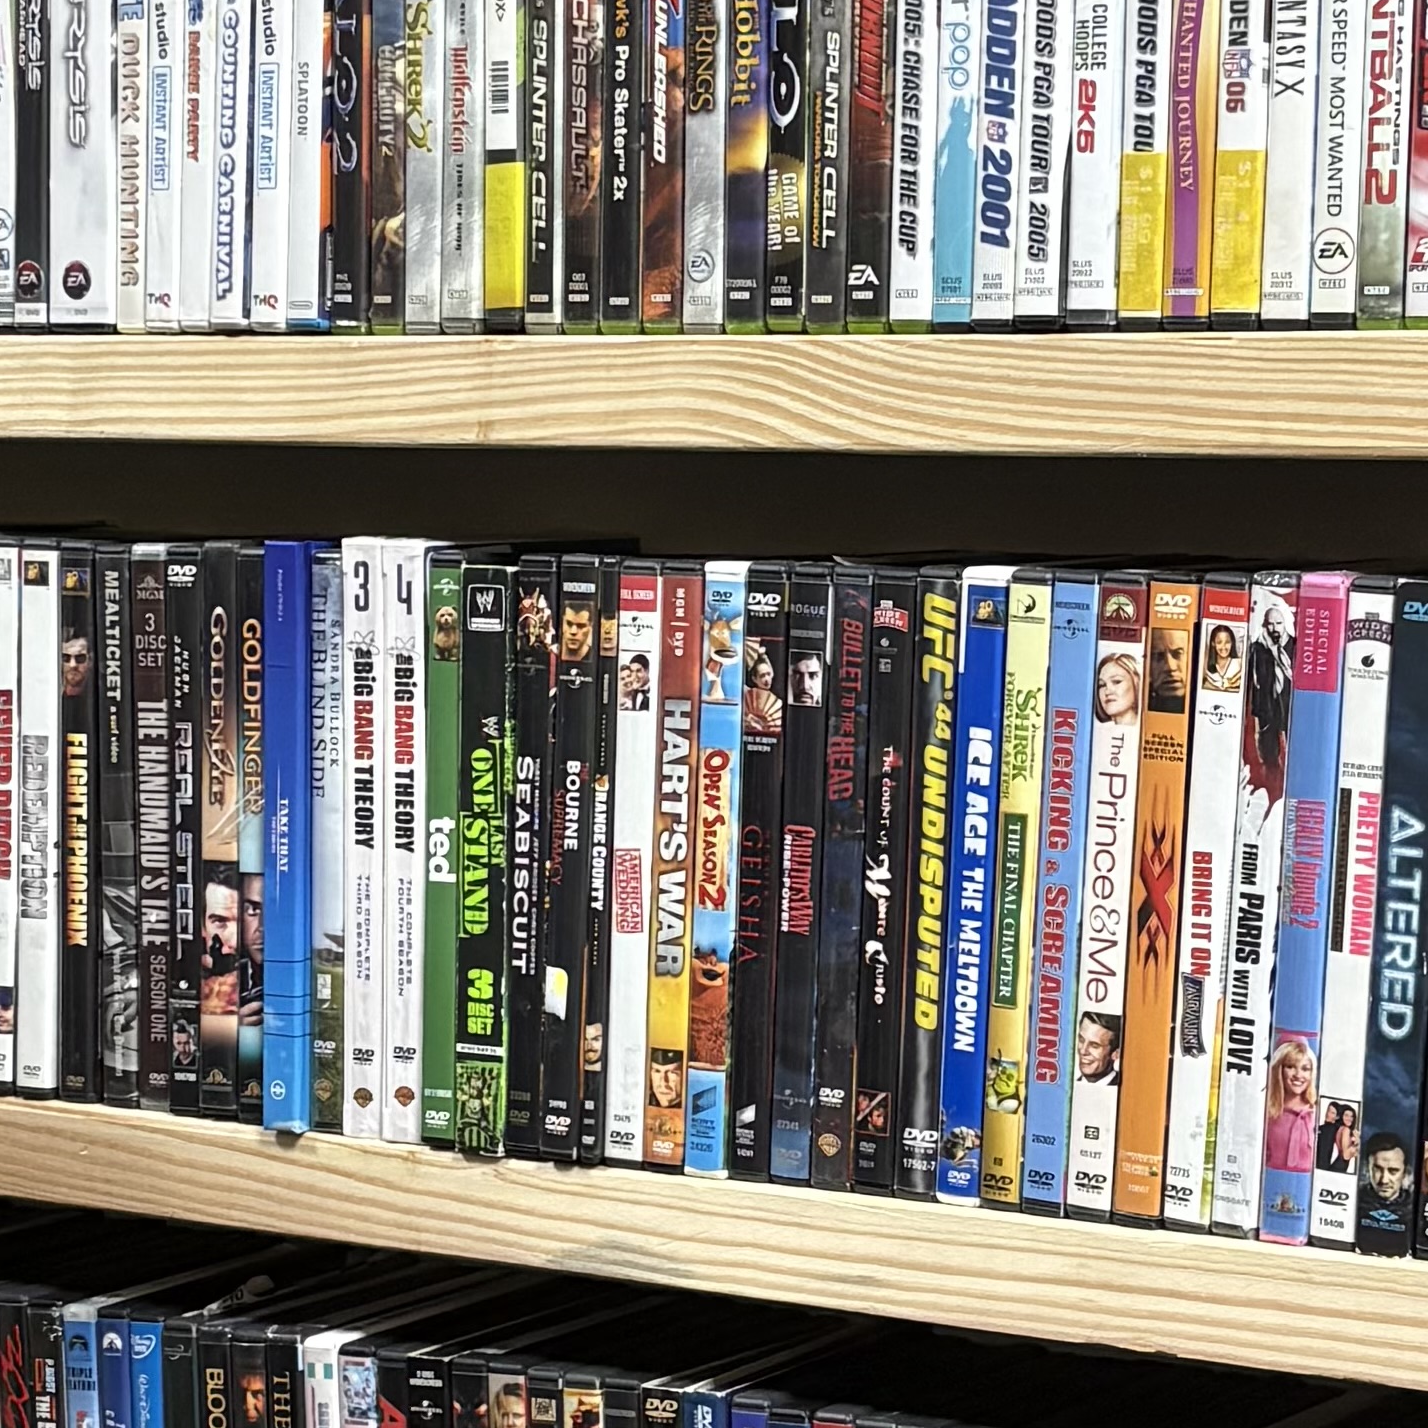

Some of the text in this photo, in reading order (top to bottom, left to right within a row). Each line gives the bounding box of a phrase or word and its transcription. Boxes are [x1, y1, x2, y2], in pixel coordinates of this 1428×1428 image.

[614, 45, 630, 76] Pro
[1074, 19, 1090, 71] HOOPS
[1091, 4, 1108, 71] COLLEGE
[297, 62, 309, 136] SPLATOON
[614, 77, 629, 155] Skater
[901, 50, 922, 120] CHASE
[1329, 76, 1346, 130] MOST
[900, 121, 919, 164] FOR
[1326, 134, 1345, 217] WANTED
[613, 176, 626, 202] 2x
[899, 166, 918, 209] THE
[980, 152, 1013, 249] 2001
[898, 213, 916, 258] CUP
[135, 635, 167, 651] DISC
[144, 613, 156, 631] 3
[138, 651, 162, 668] SET
[428, 817, 456, 883] ted
[513, 756, 535, 975] SEABISCUIT
[953, 726, 993, 1052] ICE AGE THE MELTDOWN
[1190, 851, 1213, 977] BRING IT ON
[1378, 806, 1426, 1040] ALTERED
